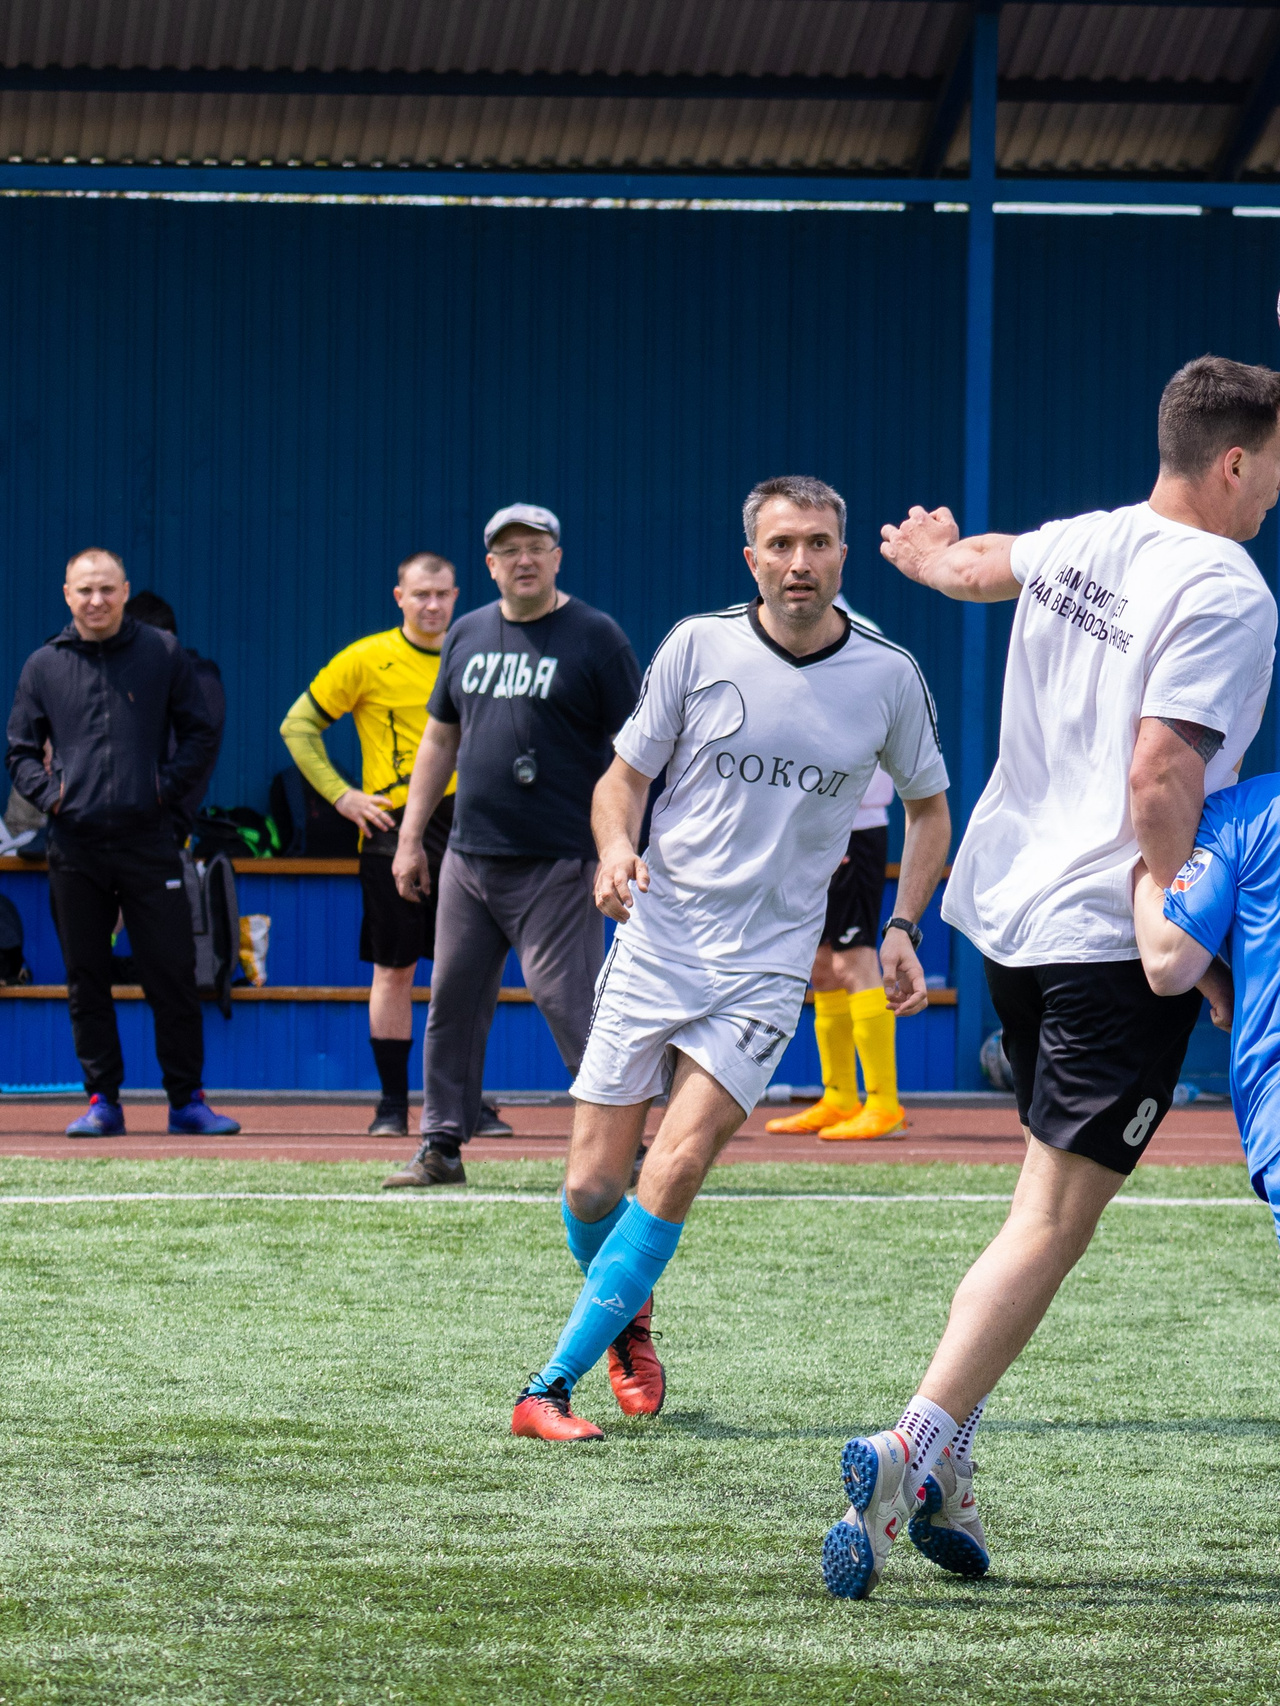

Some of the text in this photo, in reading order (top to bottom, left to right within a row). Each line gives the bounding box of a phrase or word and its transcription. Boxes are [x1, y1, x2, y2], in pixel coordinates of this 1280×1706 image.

[1055, 565, 1086, 591] НАМ
[1083, 581, 1115, 608] СИЛ
[461, 652, 559, 699] СУДЬЯ
[715, 752, 850, 798] СОКОЛ
[735, 1017, 787, 1067] 17
[1122, 1097, 1158, 1147] 8
